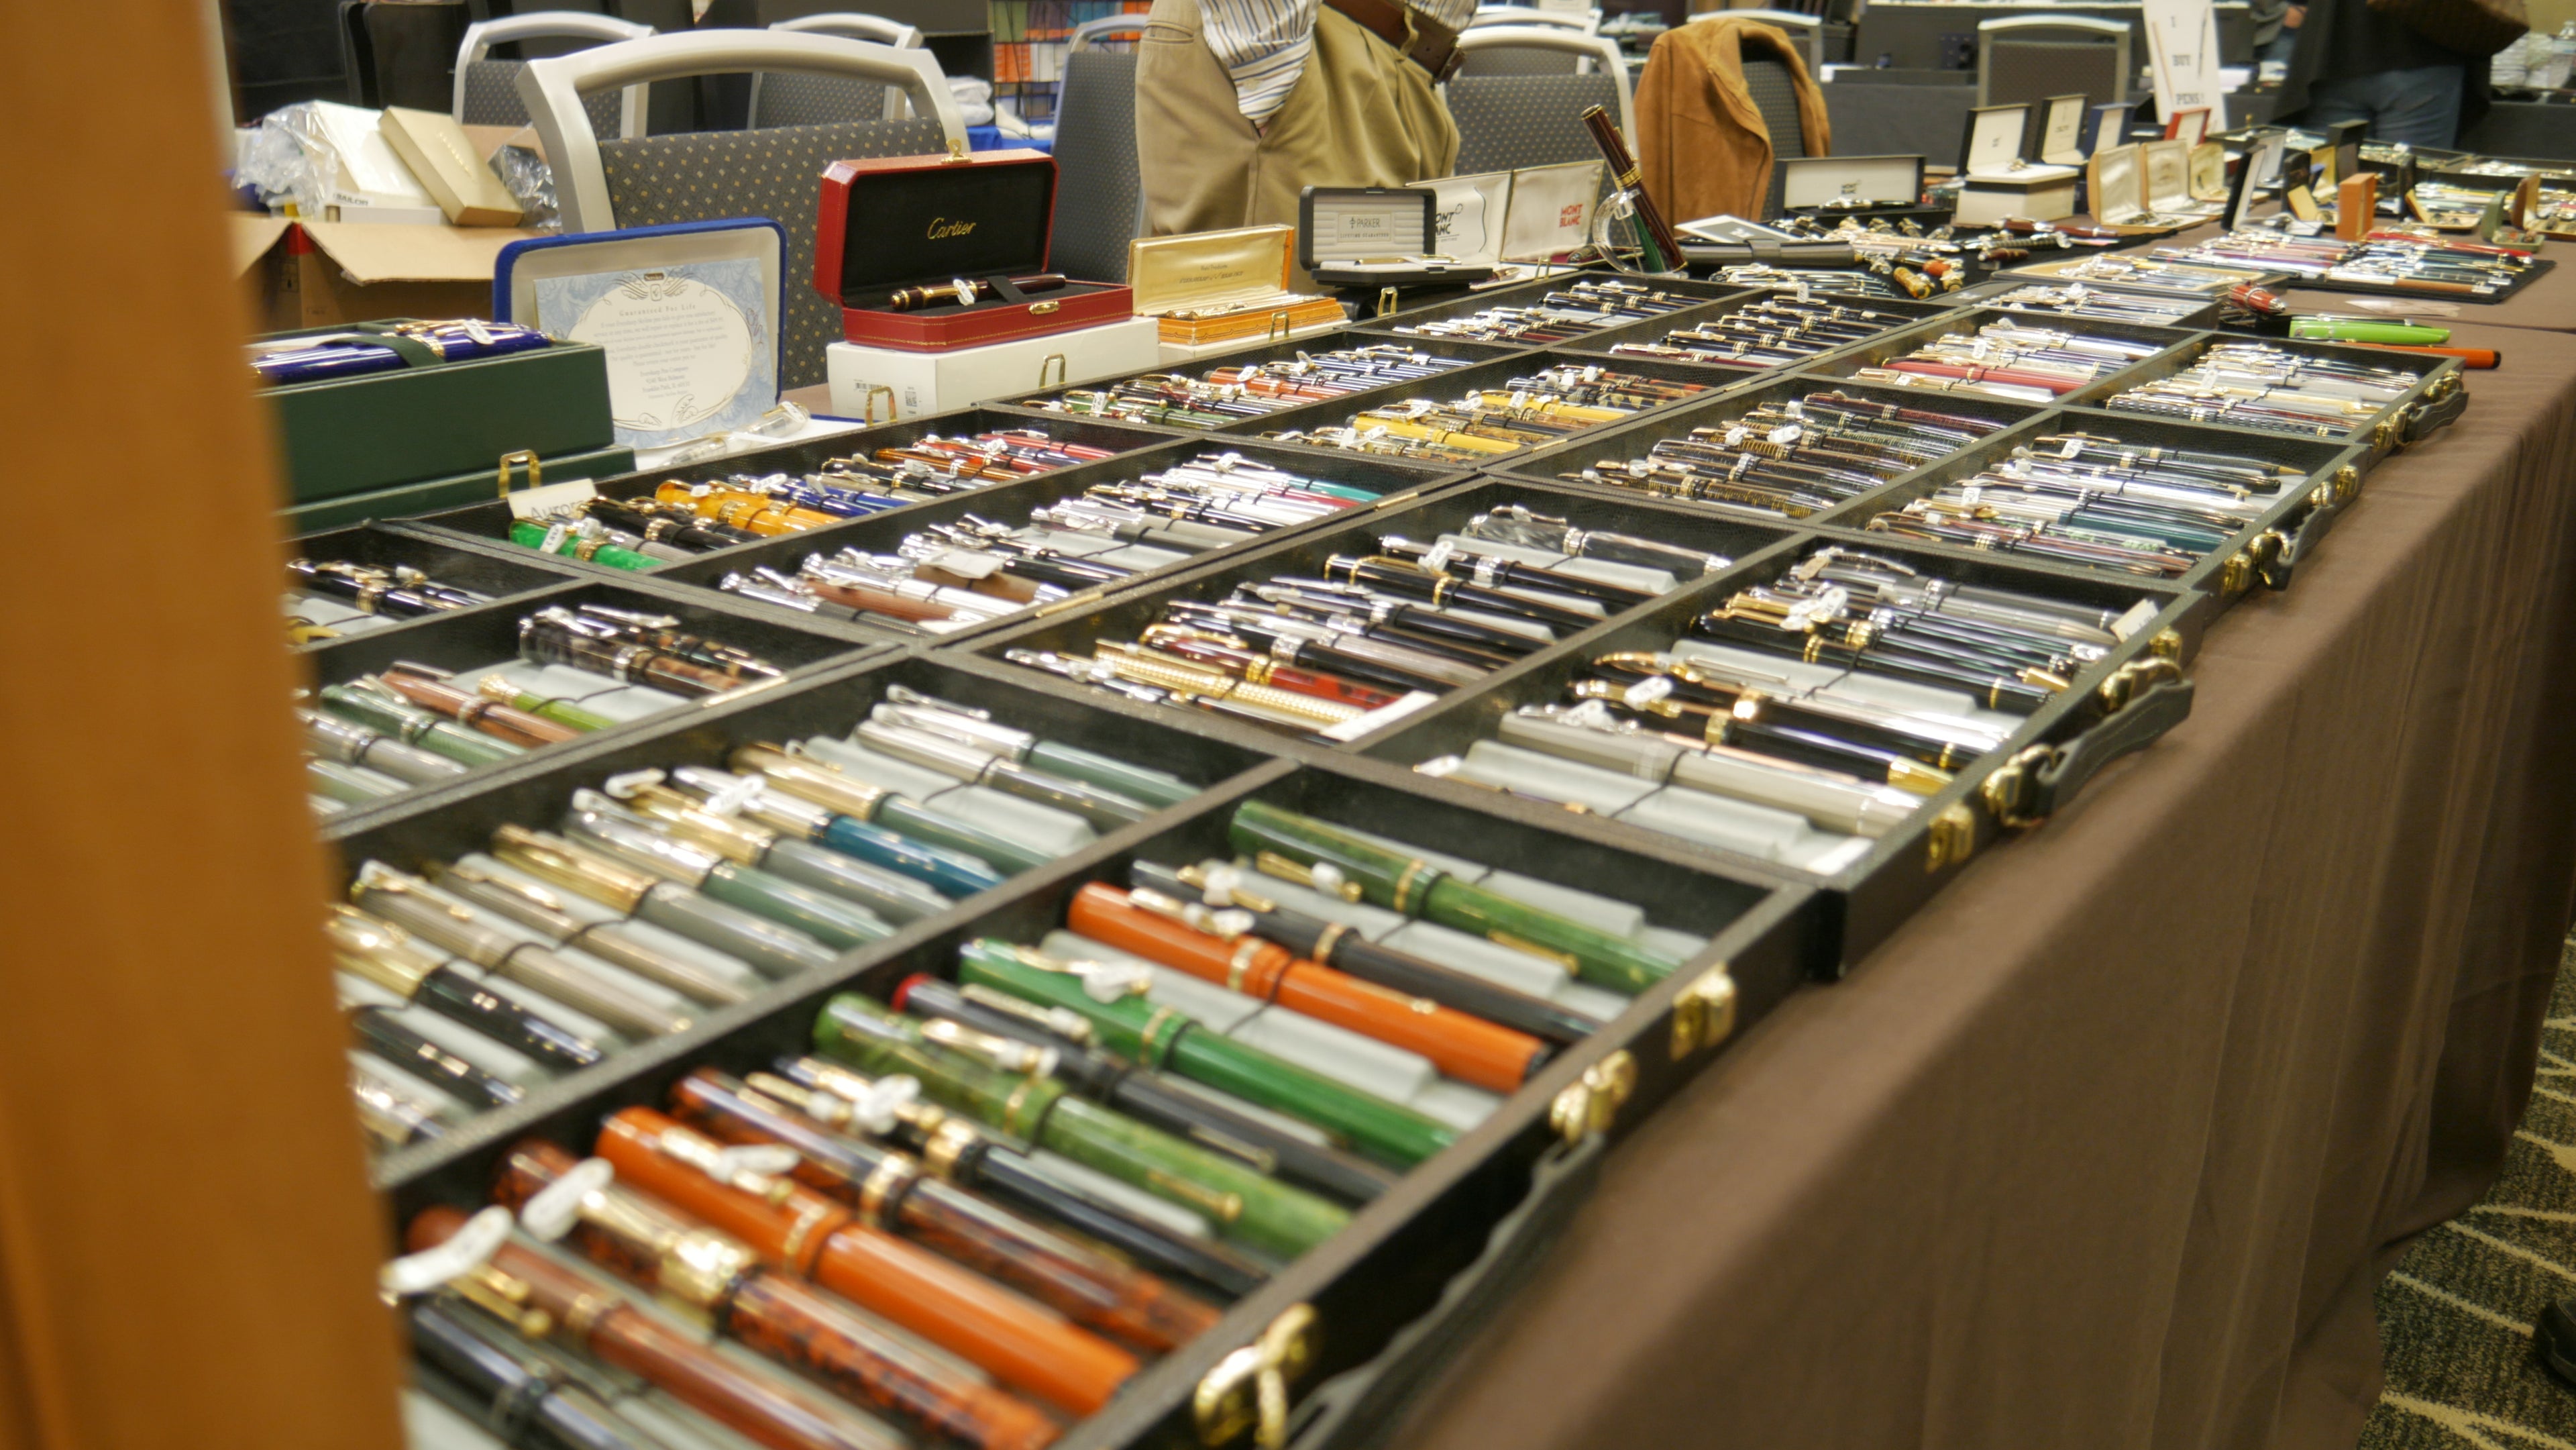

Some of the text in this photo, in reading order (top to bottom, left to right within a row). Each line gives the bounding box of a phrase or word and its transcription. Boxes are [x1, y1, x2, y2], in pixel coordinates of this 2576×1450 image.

[2172, 54, 2191, 66] BUY
[1436, 211, 1455, 223] ONT
[1560, 204, 1583, 217] MONT
[1356, 217, 1381, 228] PARKER
[1559, 215, 1581, 228] BLANC
[927, 217, 977, 240] Cartier
[1435, 223, 1452, 236] ANC
[619, 306, 661, 317] Guaranteed
[681, 303, 696, 311] Life
